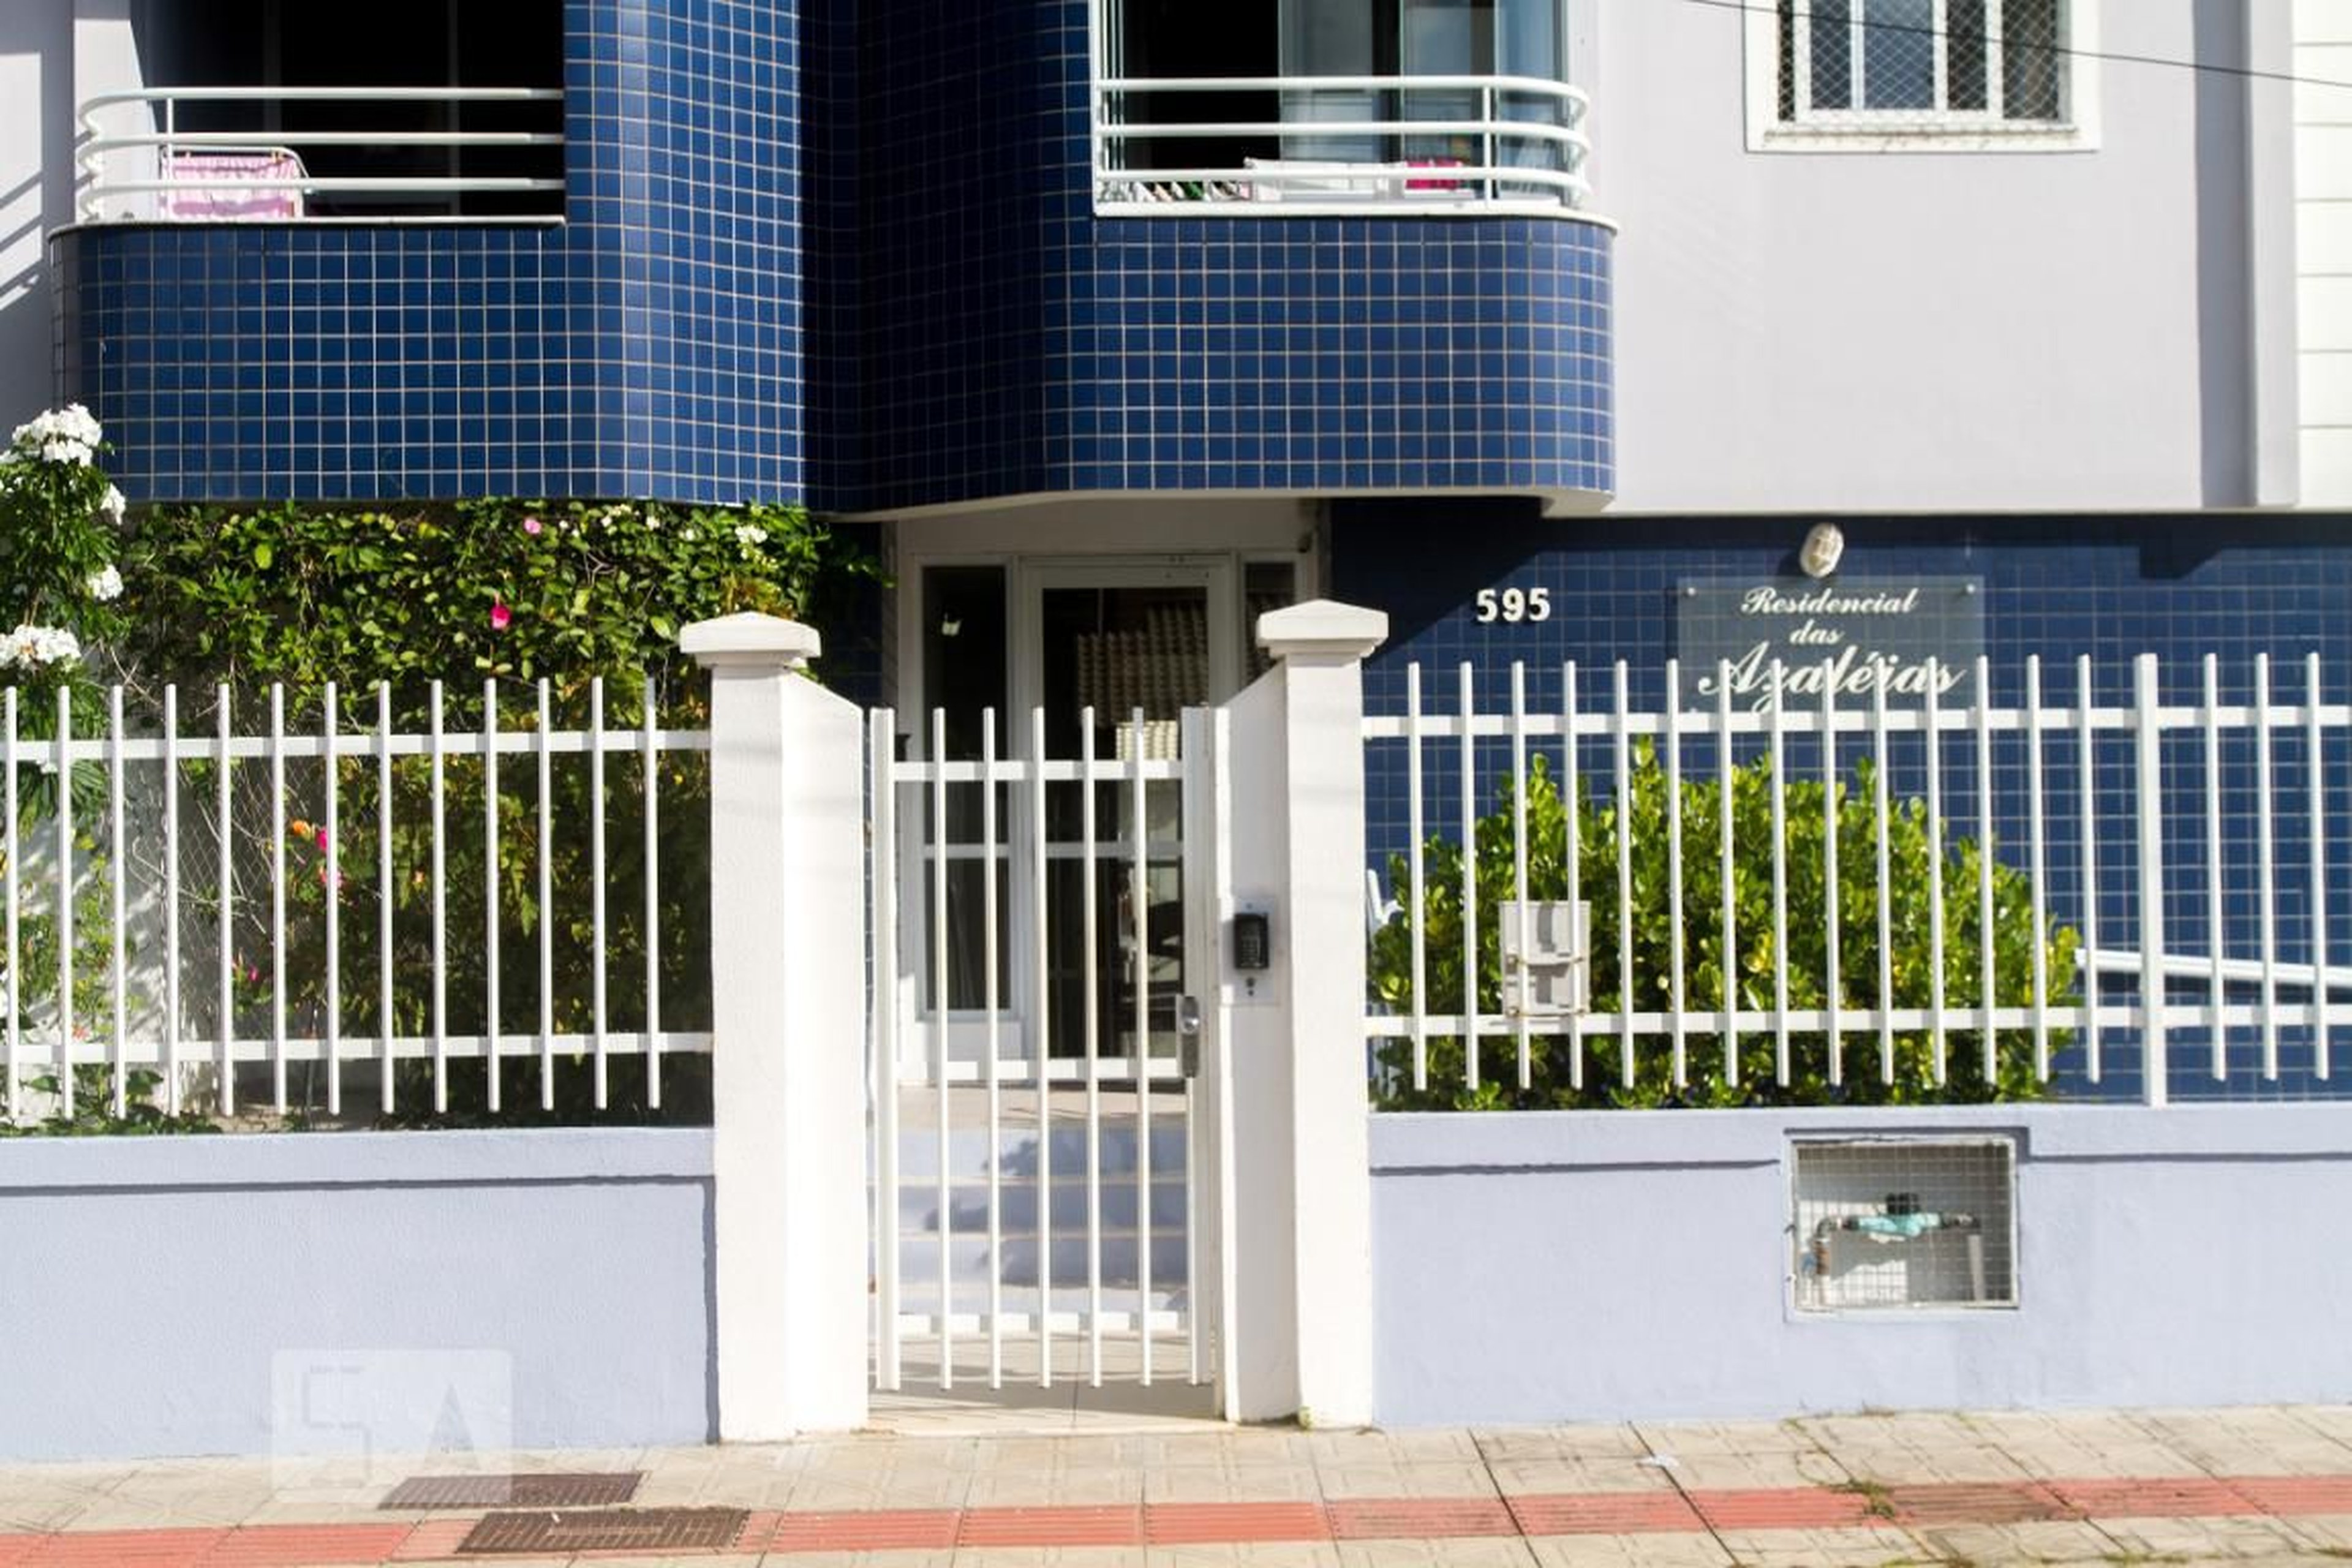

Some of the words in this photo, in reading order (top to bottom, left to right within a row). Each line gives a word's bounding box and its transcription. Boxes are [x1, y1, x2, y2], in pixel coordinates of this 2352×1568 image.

[1477, 587, 1551, 622] 595
[1741, 586, 1918, 614] Residencial
[1789, 619, 1844, 644] das
